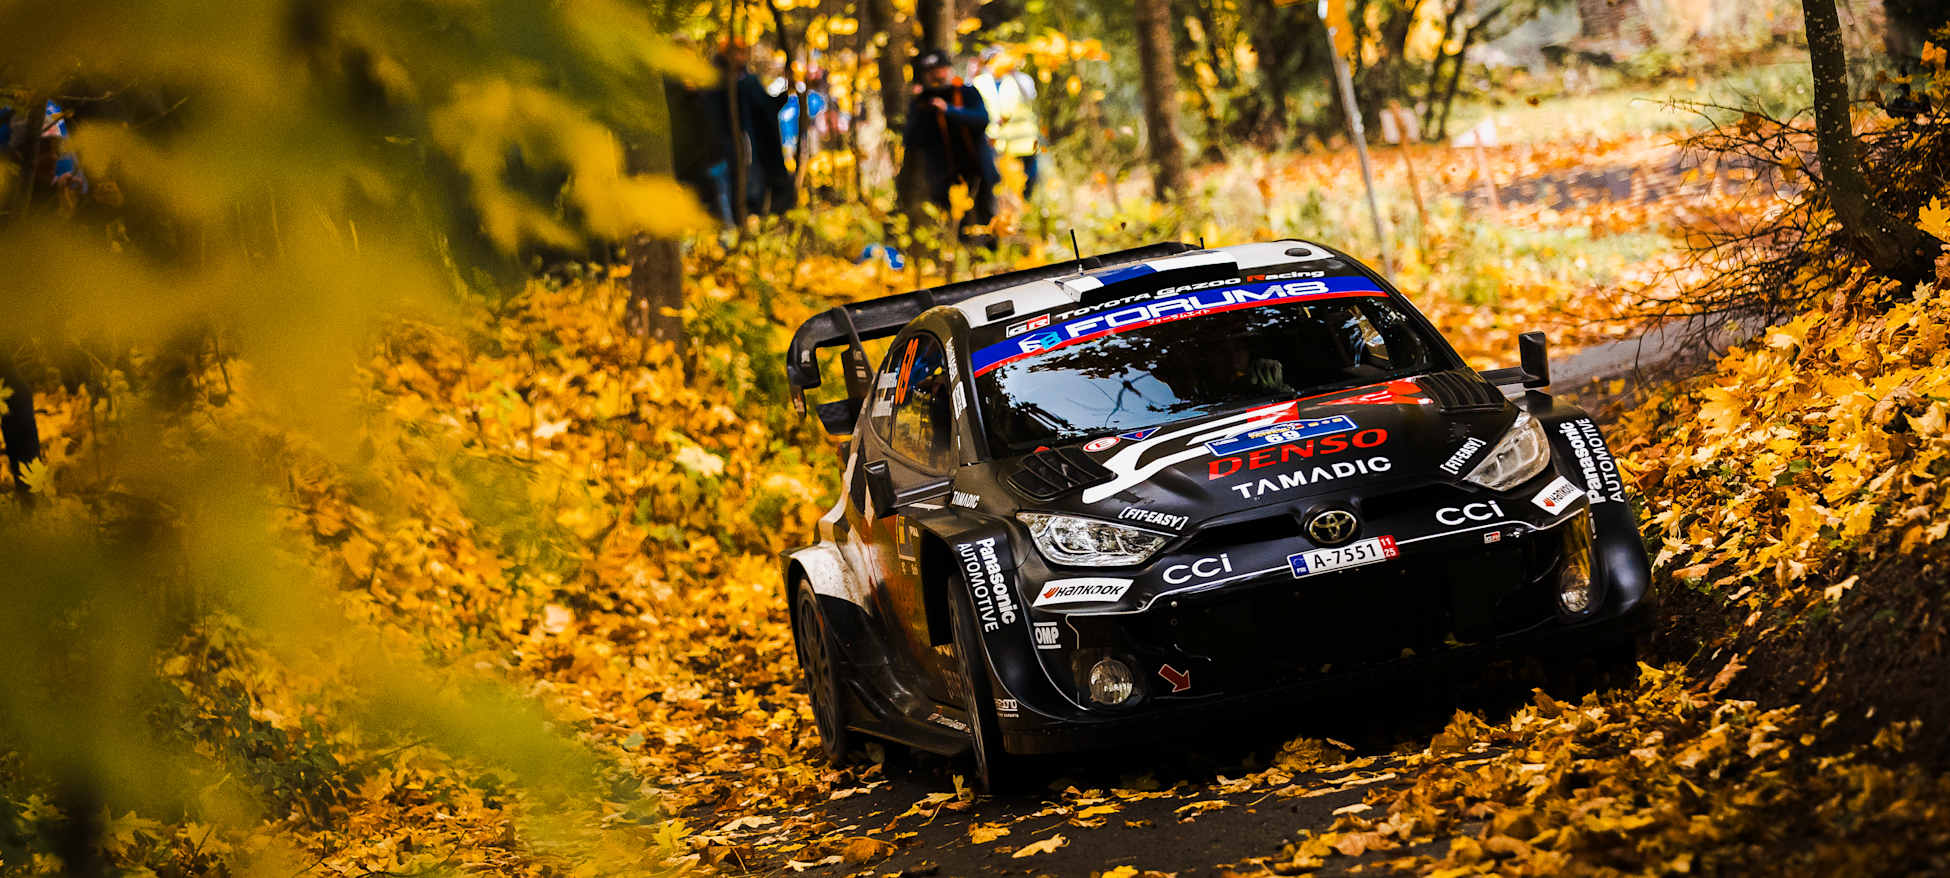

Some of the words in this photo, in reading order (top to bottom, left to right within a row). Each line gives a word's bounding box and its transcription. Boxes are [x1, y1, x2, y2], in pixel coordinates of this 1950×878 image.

[1055, 292, 1151, 320] TOYOTA
[1153, 277, 1241, 300] GAZOO
[1246, 270, 1325, 283] Racing
[1064, 280, 1330, 339] FORUM8
[1207, 428, 1389, 481] DENSO
[1264, 430, 1301, 444] 69
[1575, 418, 1625, 503] AUTOMOTIVE
[1231, 455, 1393, 500] TAMADIC
[1559, 421, 1607, 505] Panasonic
[1313, 543, 1377, 569] A-7551
[1380, 537, 1392, 547] 11
[1384, 548, 1397, 558] 25
[957, 542, 999, 633] AUTOMOTIVE
[976, 536, 1018, 625] Panasonic
[1034, 627, 1060, 645] OMP
